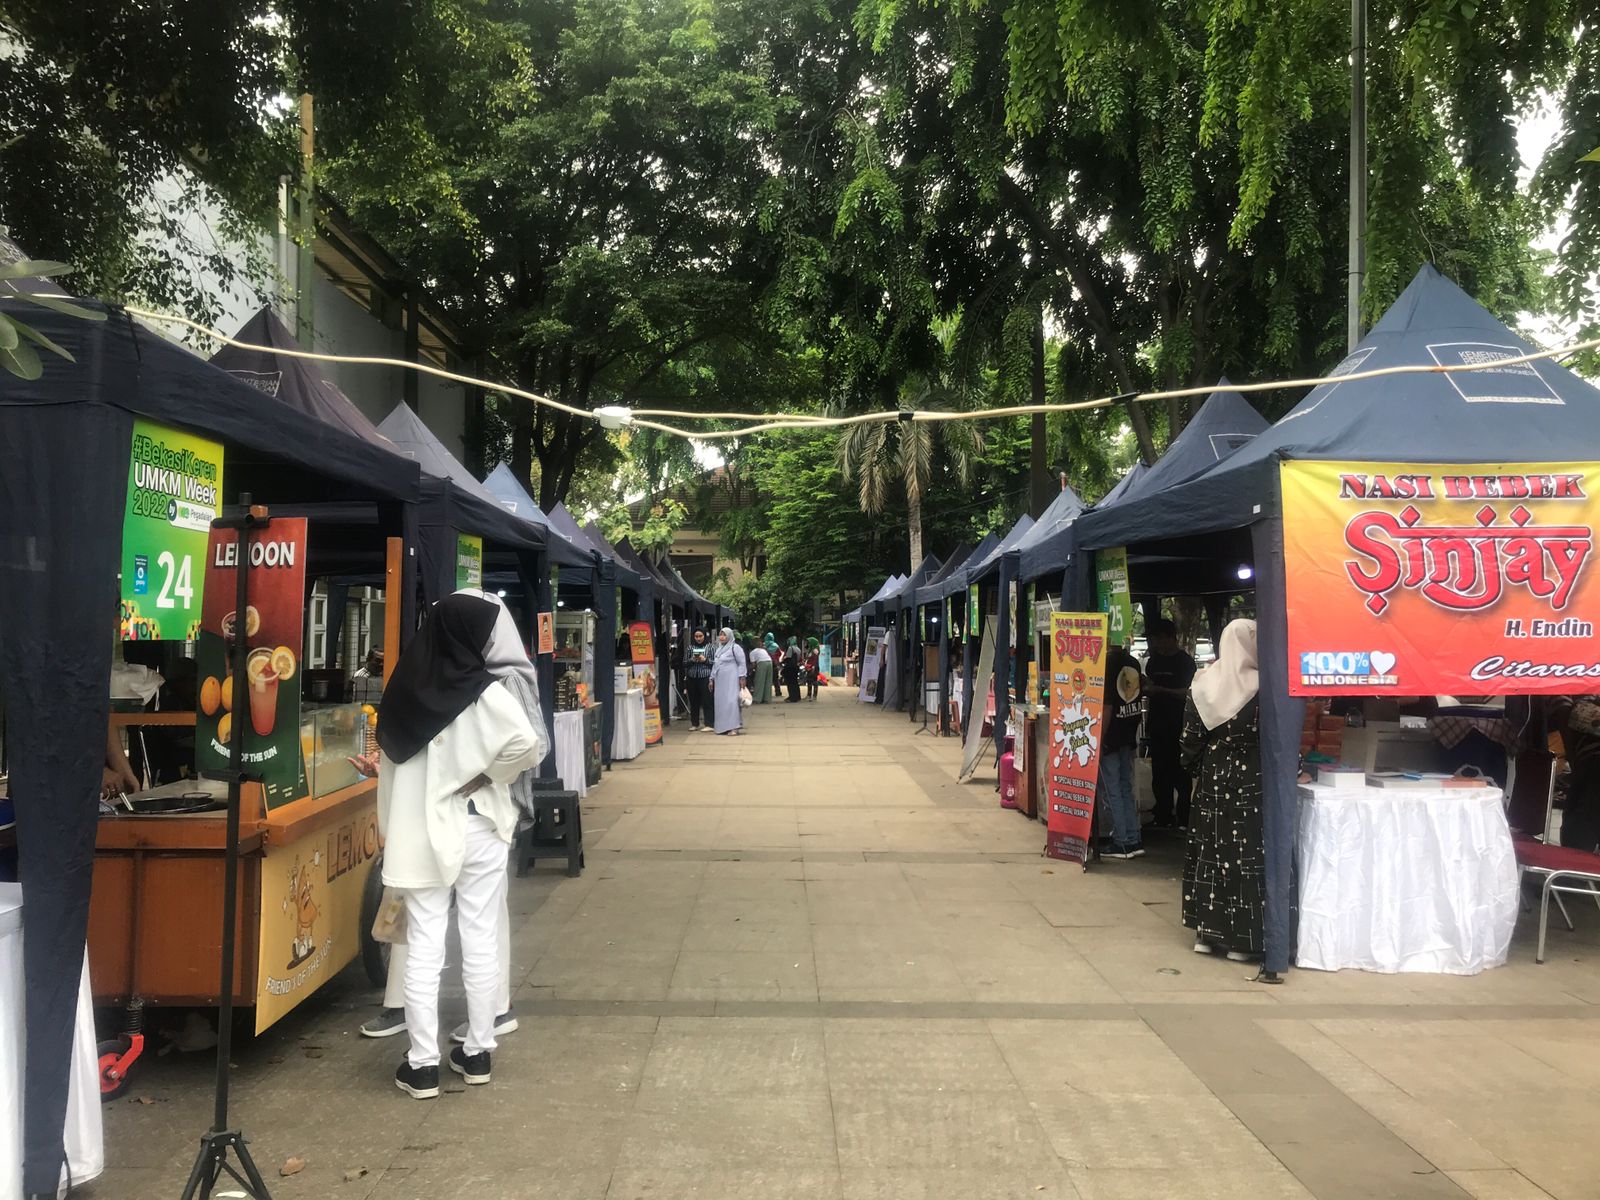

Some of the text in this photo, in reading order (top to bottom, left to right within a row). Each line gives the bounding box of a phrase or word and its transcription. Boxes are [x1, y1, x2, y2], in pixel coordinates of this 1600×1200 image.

[134, 434, 217, 482] #BekasiKeren
[134, 461, 217, 506] UMKM Week
[1339, 475, 1587, 499] NASI BEBEK
[132, 489, 168, 520] 2022
[1345, 505, 1592, 615] Sinjay
[156, 551, 194, 609] 24
[1109, 605, 1124, 631] 25
[1505, 618, 1592, 637] H. Endin
[1055, 629, 1104, 665] Sinjay
[1302, 652, 1369, 675] 100%
[1301, 675, 1398, 685] INDONESIA
[211, 737, 231, 759] FRIEN
[250, 752, 263, 762] THE
[264, 746, 278, 760] SUN
[327, 812, 384, 884] LEMO
[297, 969, 307, 987] OF
[307, 955, 320, 977] THE
